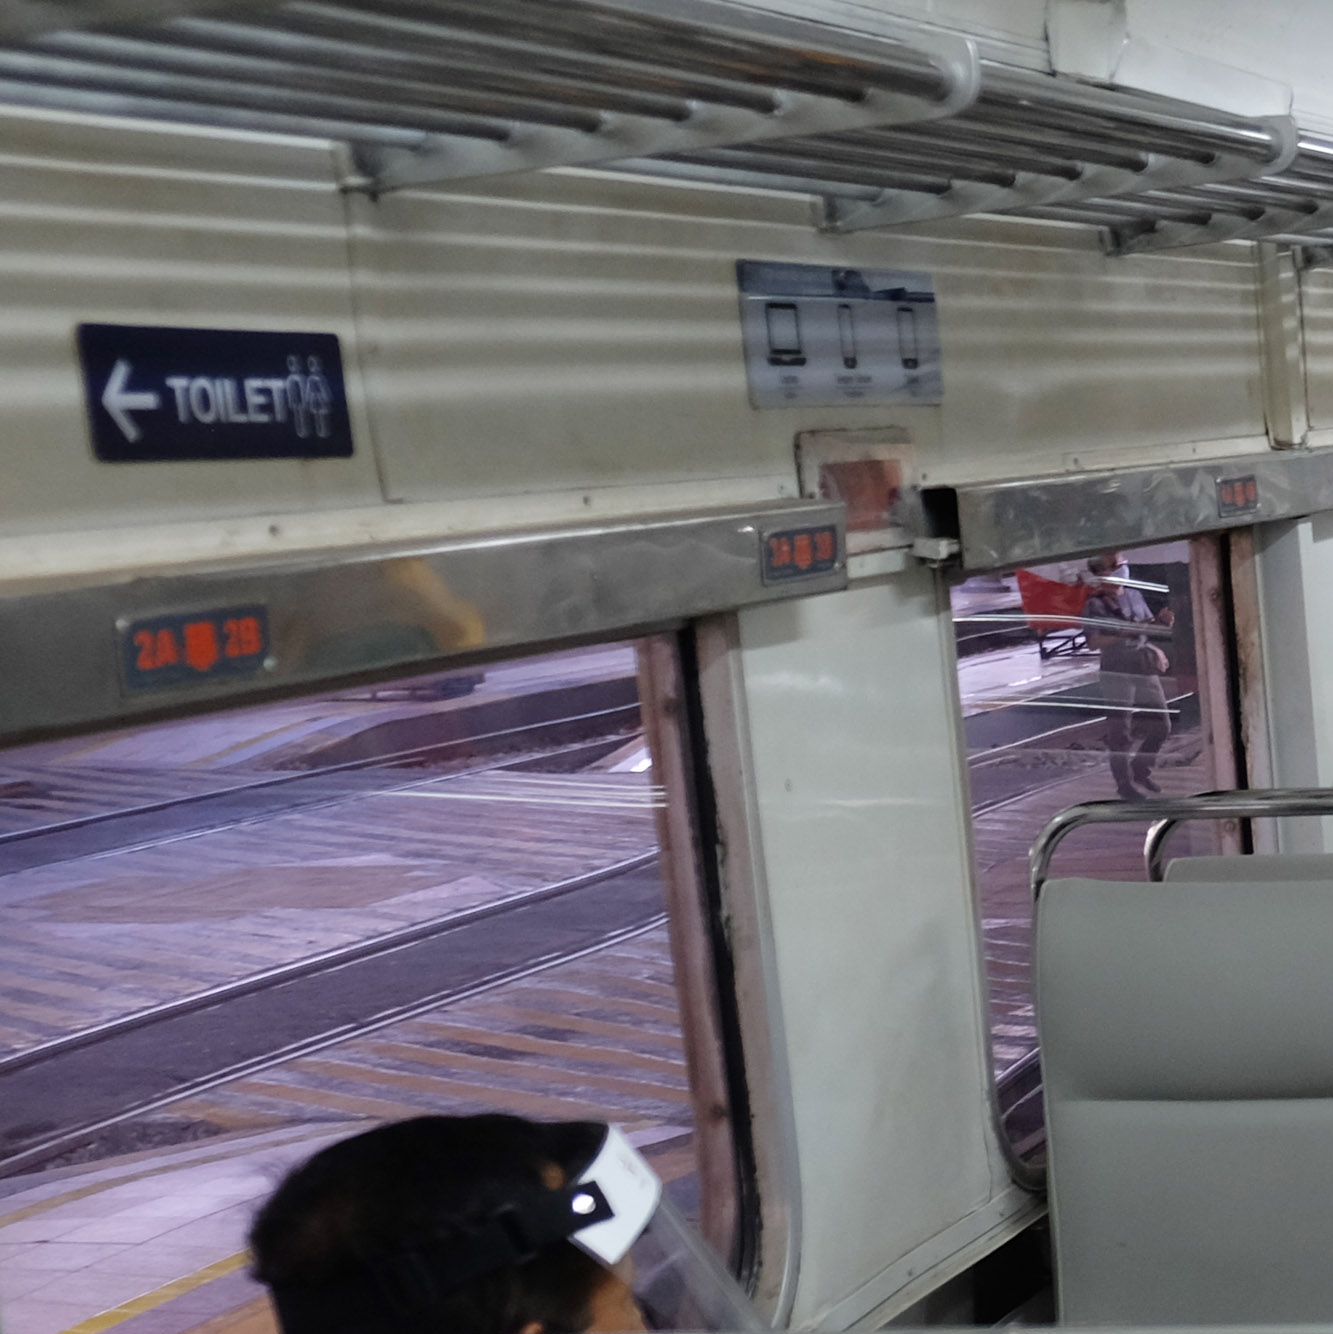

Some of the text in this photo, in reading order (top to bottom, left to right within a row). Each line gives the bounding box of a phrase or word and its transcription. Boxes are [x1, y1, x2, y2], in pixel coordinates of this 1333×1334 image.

[165, 375, 288, 425] TOILET
[133, 616, 262, 671] 2A 2B
